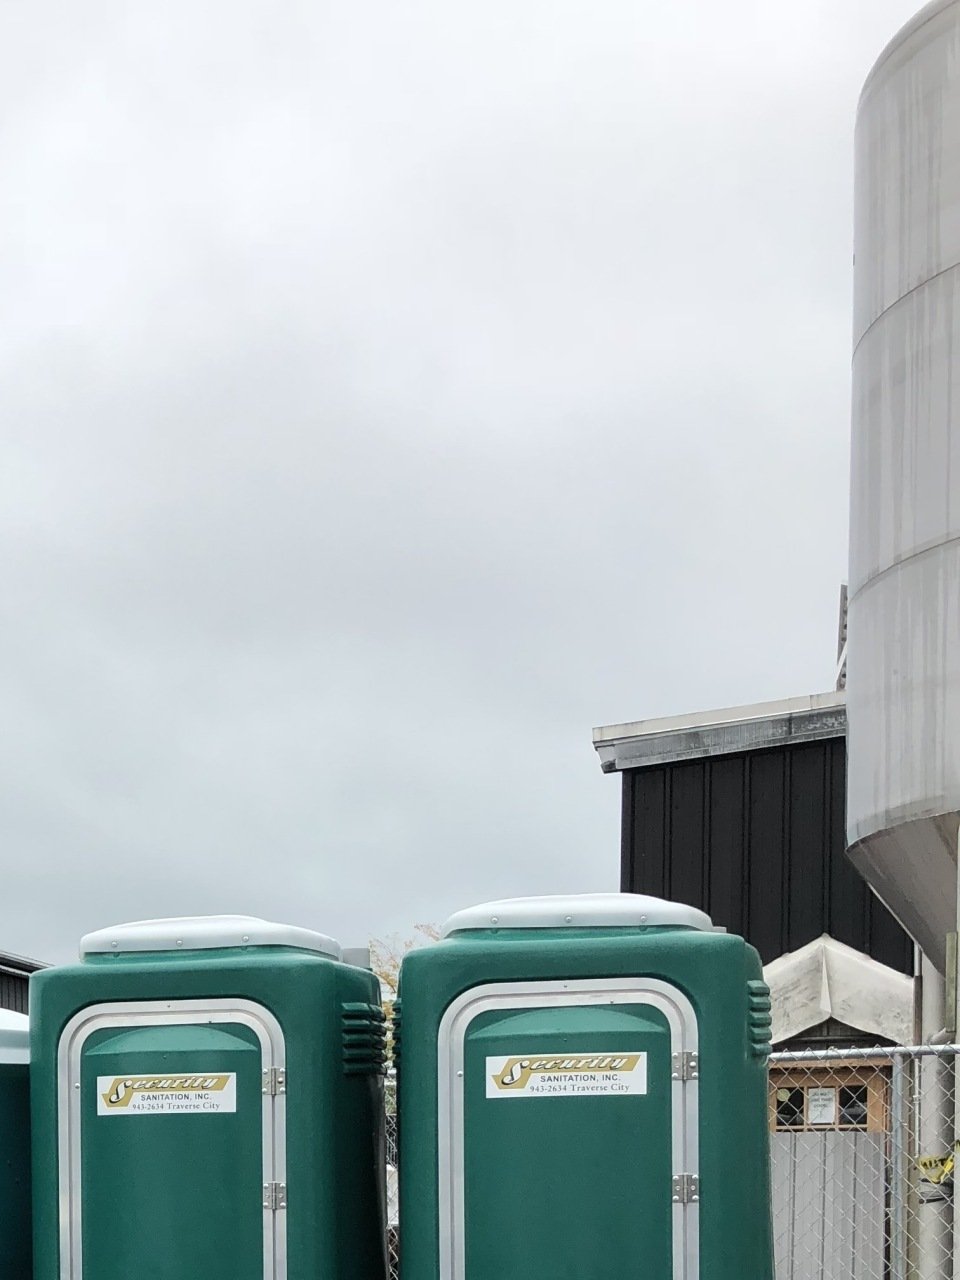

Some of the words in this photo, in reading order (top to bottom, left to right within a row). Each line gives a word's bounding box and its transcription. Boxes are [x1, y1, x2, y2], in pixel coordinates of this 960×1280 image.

[501, 1056, 629, 1085] Security
[540, 1074, 599, 1083] SANITATION,
[109, 1076, 219, 1104] Security
[529, 1084, 567, 1093] 943-2634
[570, 1083, 608, 1092] Traverse
[610, 1083, 630, 1093] City
[140, 1093, 192, 1102] SANITATION,
[194, 1093, 212, 1101] INC.
[132, 1102, 164, 1111] 943-2634
[167, 1102, 200, 1110] Traverse
[202, 1101, 221, 1111] City
